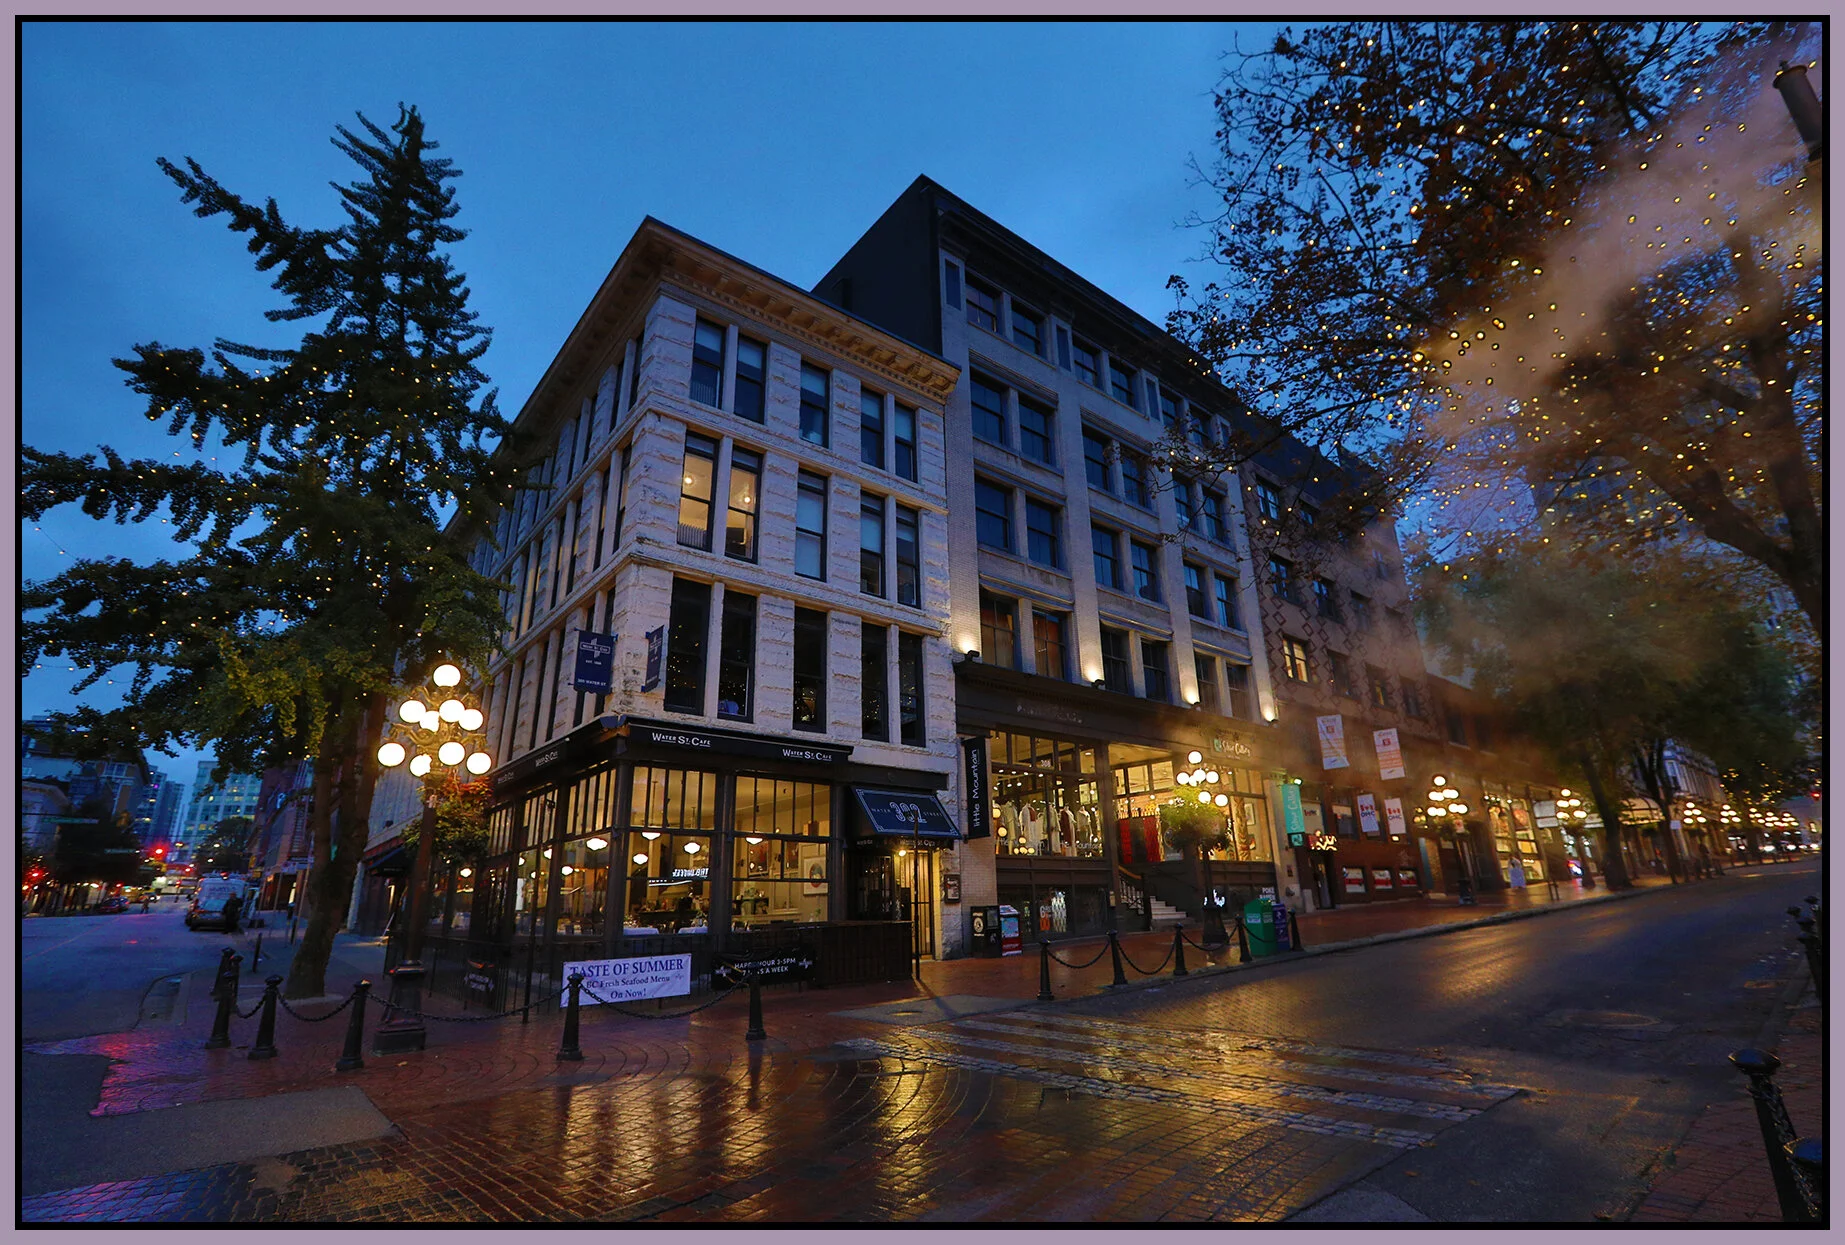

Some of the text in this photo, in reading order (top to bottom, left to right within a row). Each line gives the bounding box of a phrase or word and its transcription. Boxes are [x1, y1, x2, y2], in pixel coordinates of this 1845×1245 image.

[652, 732, 677, 743] WATER
[782, 749, 803, 759] WATER
[970, 749, 980, 799] Mountain
[569, 959, 684, 978] TASTE OF SUMMER
[600, 978, 619, 987] Fresh
[621, 976, 649, 986] Seafood
[650, 975, 670, 983] Menu
[610, 988, 646, 999] On Now!
